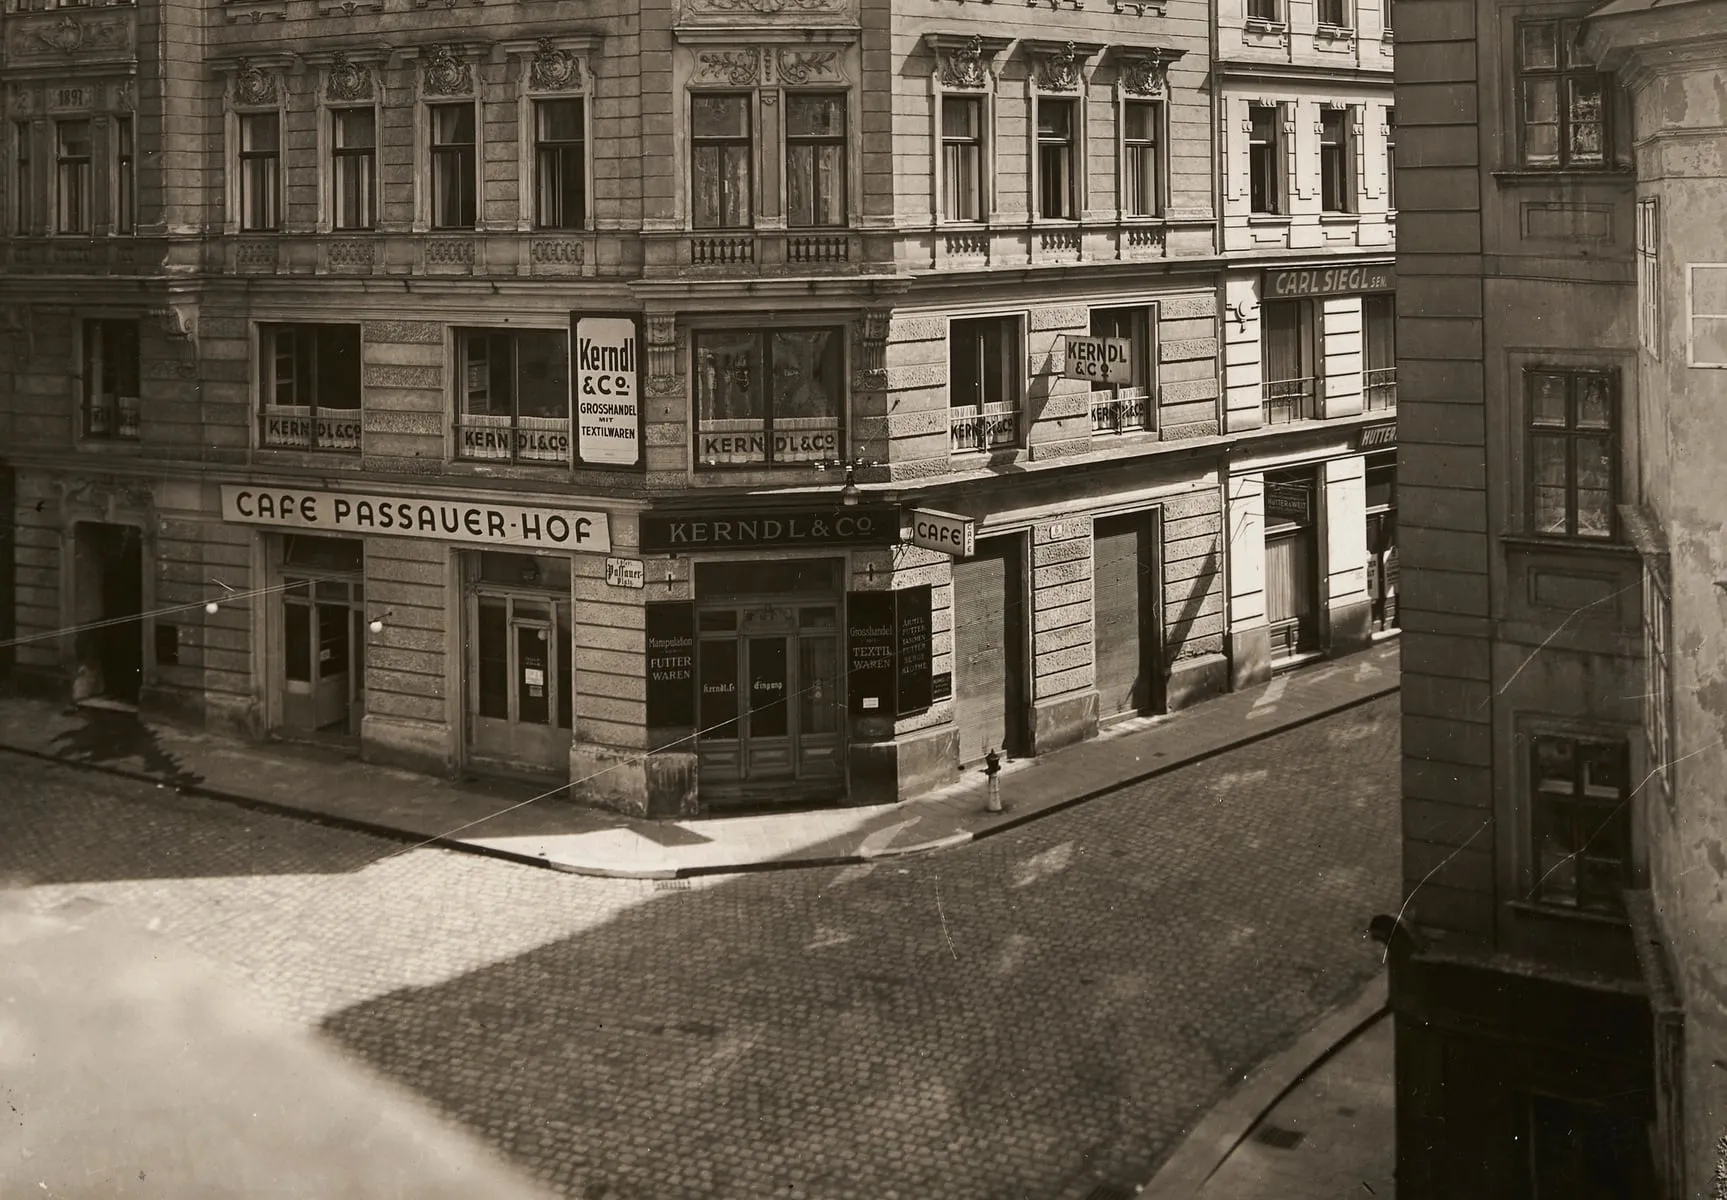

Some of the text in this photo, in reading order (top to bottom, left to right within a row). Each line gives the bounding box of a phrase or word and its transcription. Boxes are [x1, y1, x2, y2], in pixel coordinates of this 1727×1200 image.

[1276, 268, 1387, 294] CARL SIEGL SEN.
[580, 337, 635, 372] Kerndl
[1068, 341, 1127, 363] KERNDL
[580, 403, 637, 416] GROSSHANDEL
[581, 426, 636, 440] TEXTILWAREN
[236, 490, 592, 544] CAFE PASSAUER-HOF
[918, 521, 962, 546] CAFE
[651, 656, 692, 668] FUTTER
[853, 660, 891, 670] WAREN
[652, 670, 691, 681] WAREN
